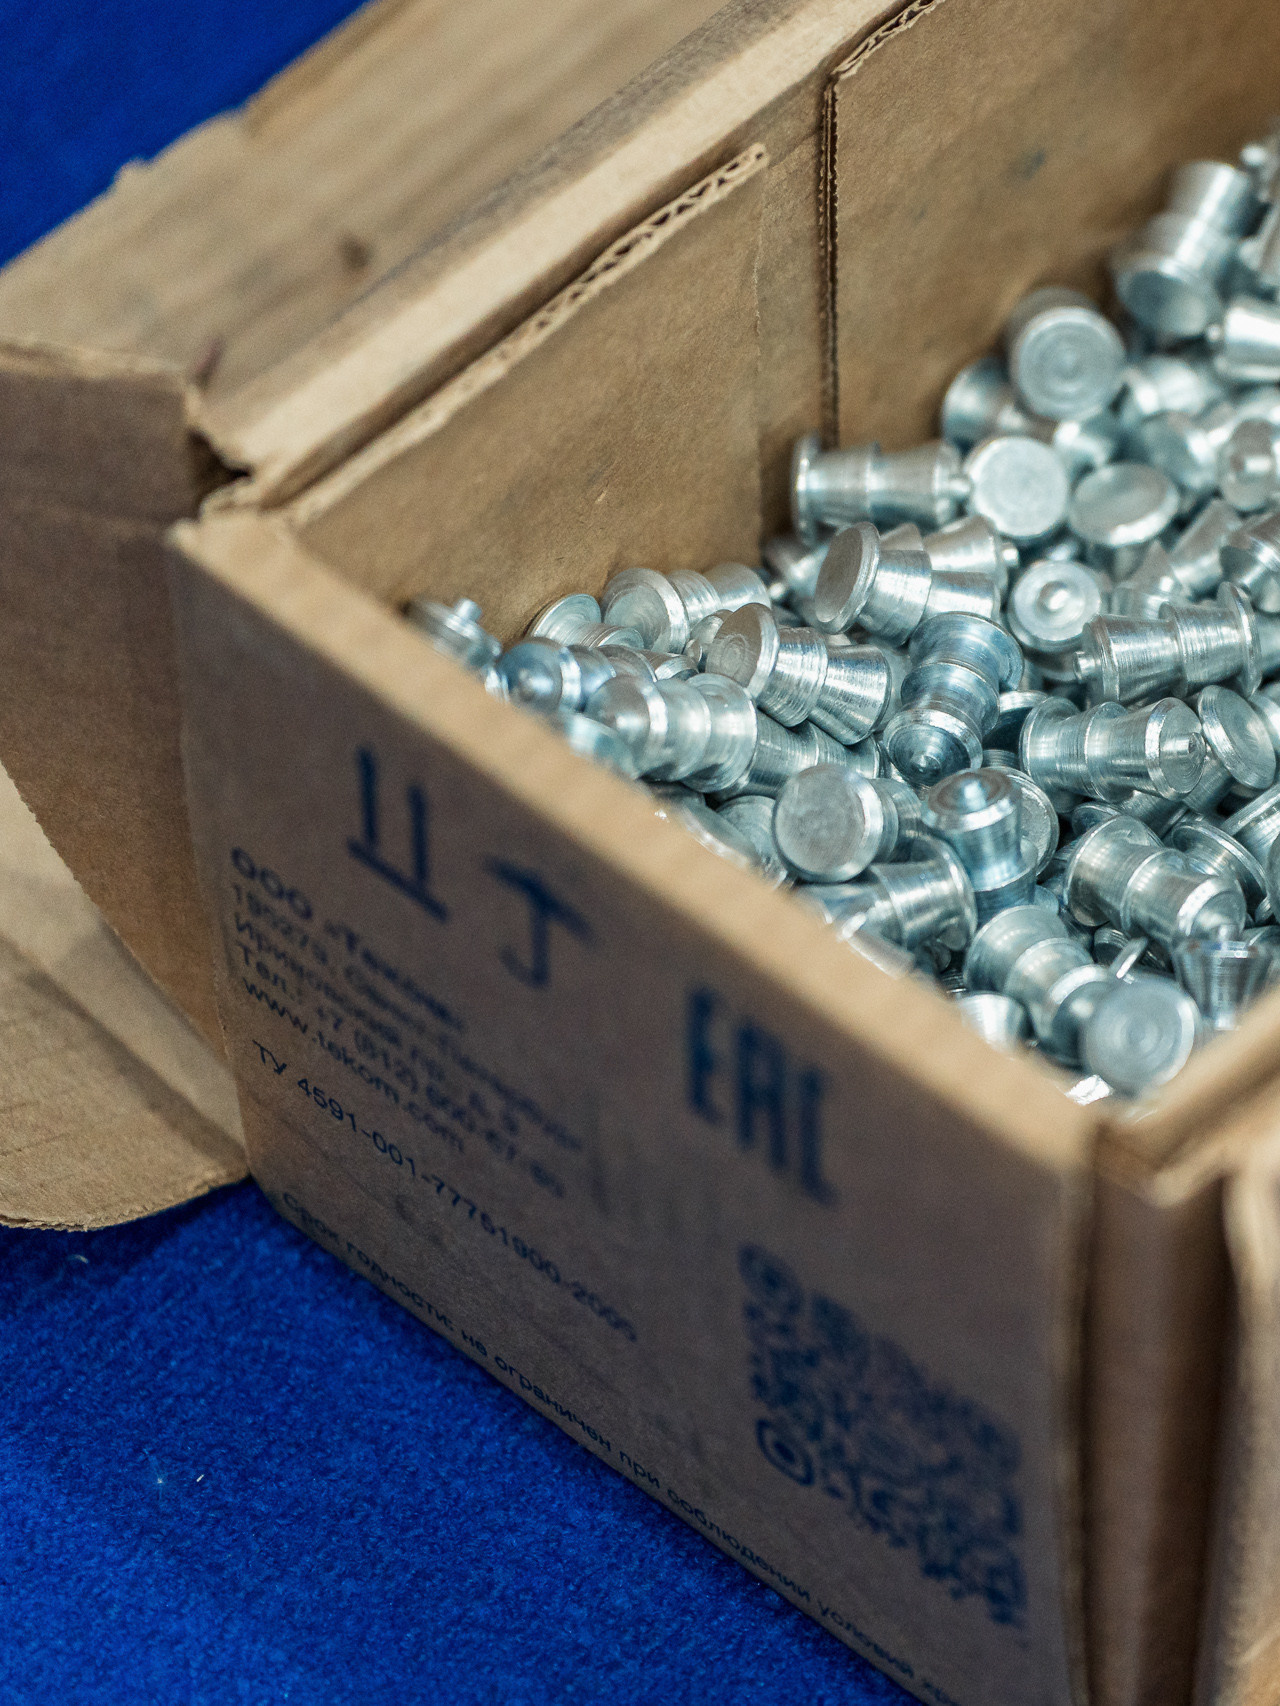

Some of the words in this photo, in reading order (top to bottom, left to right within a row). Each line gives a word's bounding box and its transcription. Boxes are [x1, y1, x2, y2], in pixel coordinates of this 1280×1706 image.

[252, 1038, 288, 1076] ТУ
[346, 1240, 453, 1332] годности:
[461, 1328, 489, 1358] не
[494, 1356, 612, 1452] ограничен
[619, 1450, 661, 1489] при
[666, 1487, 811, 1602] соблюдении
